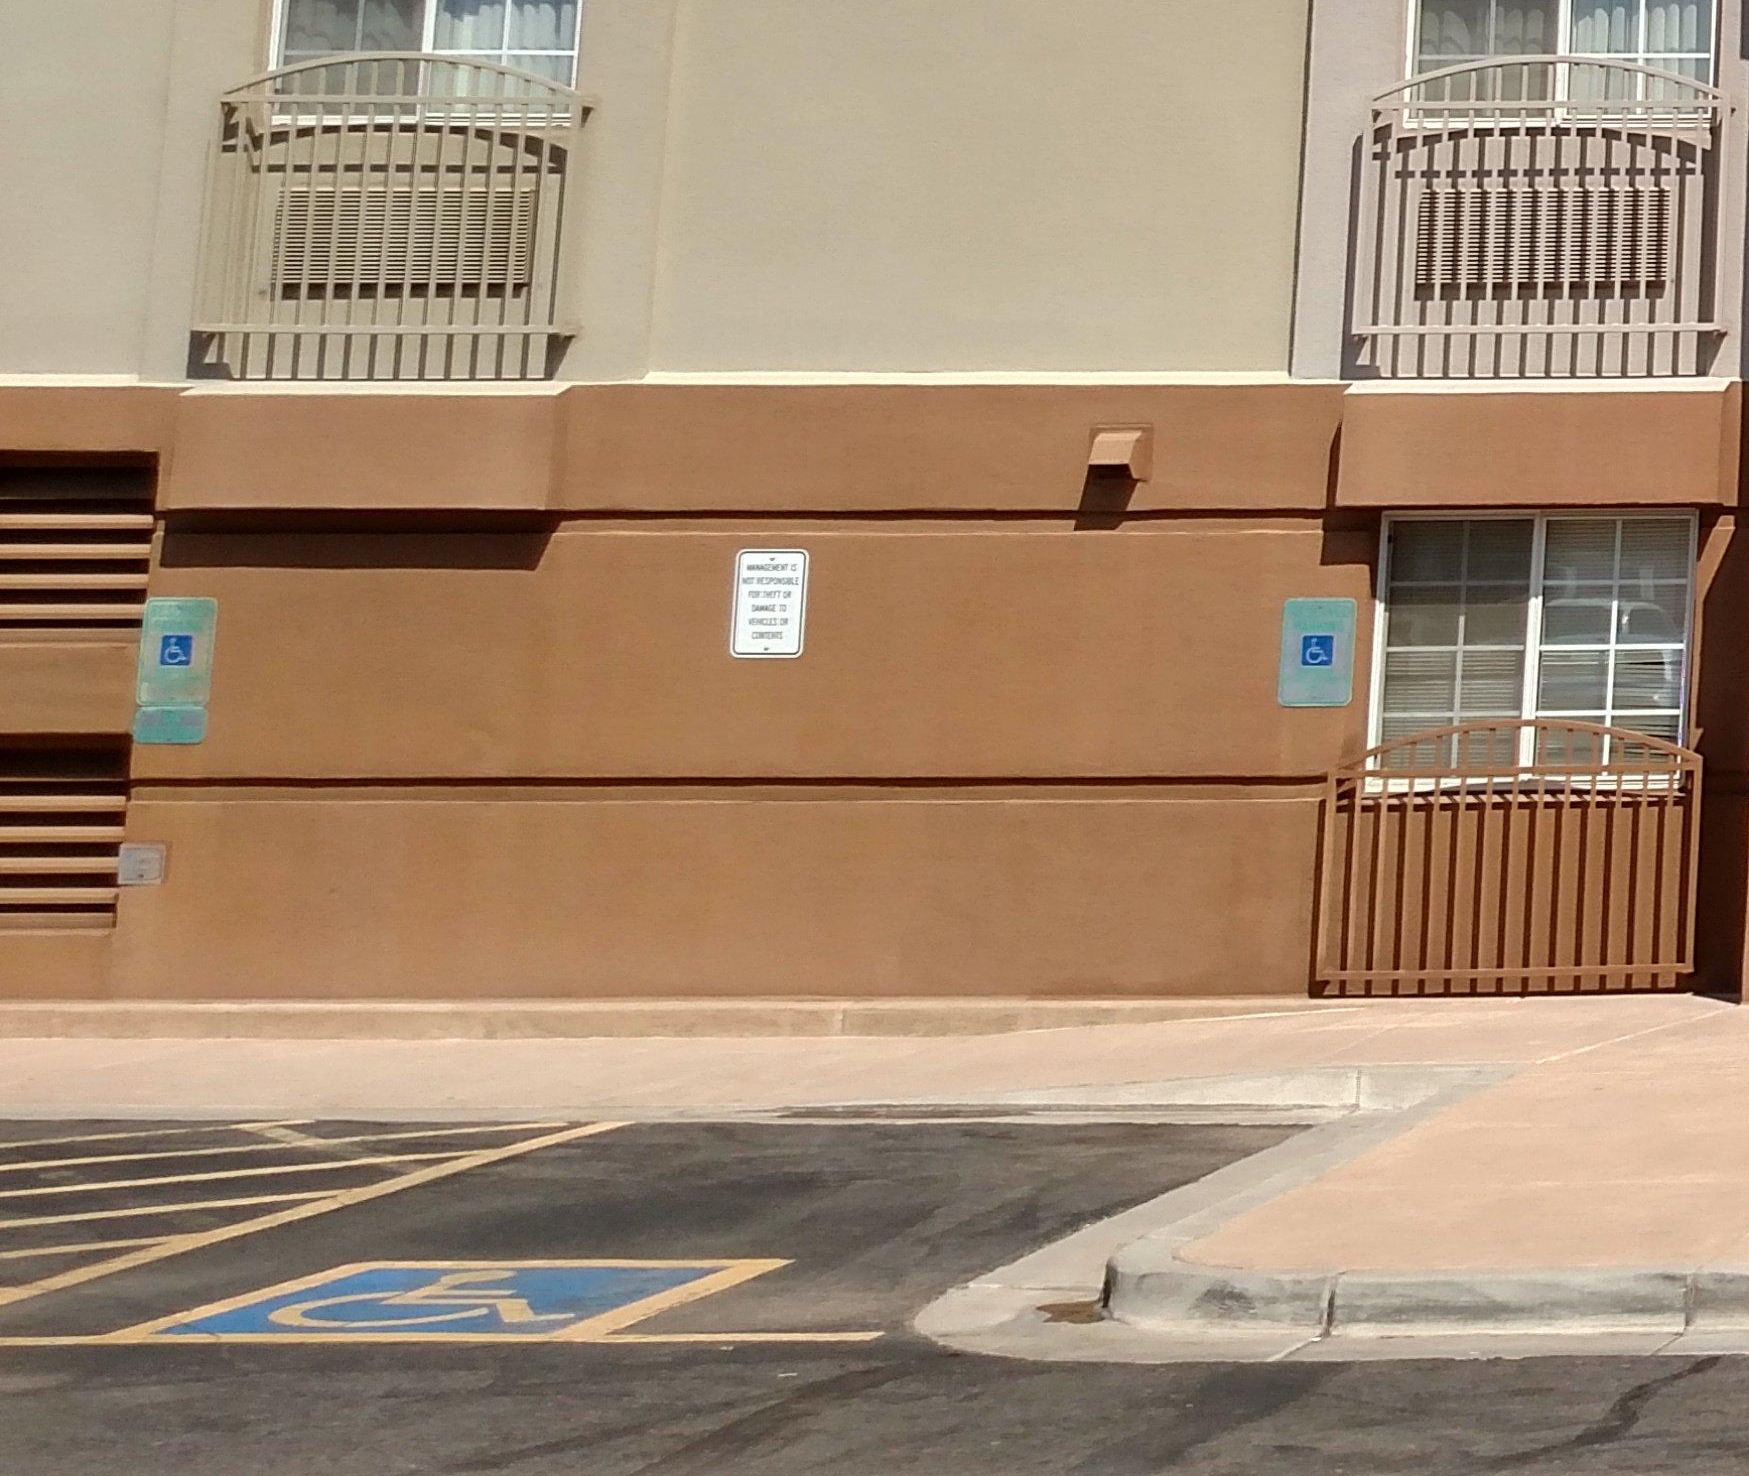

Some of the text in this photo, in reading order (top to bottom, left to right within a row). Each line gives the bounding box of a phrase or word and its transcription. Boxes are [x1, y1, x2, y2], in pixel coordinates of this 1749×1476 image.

[746, 564, 798, 572] MANAGEMENT IS
[742, 577, 799, 586] NOT RESPONSIBLE
[748, 591, 761, 599] FOR
[783, 591, 791, 599] OR
[751, 604, 787, 613] DAMAGE TO
[748, 618, 789, 626] VEHICLES OR
